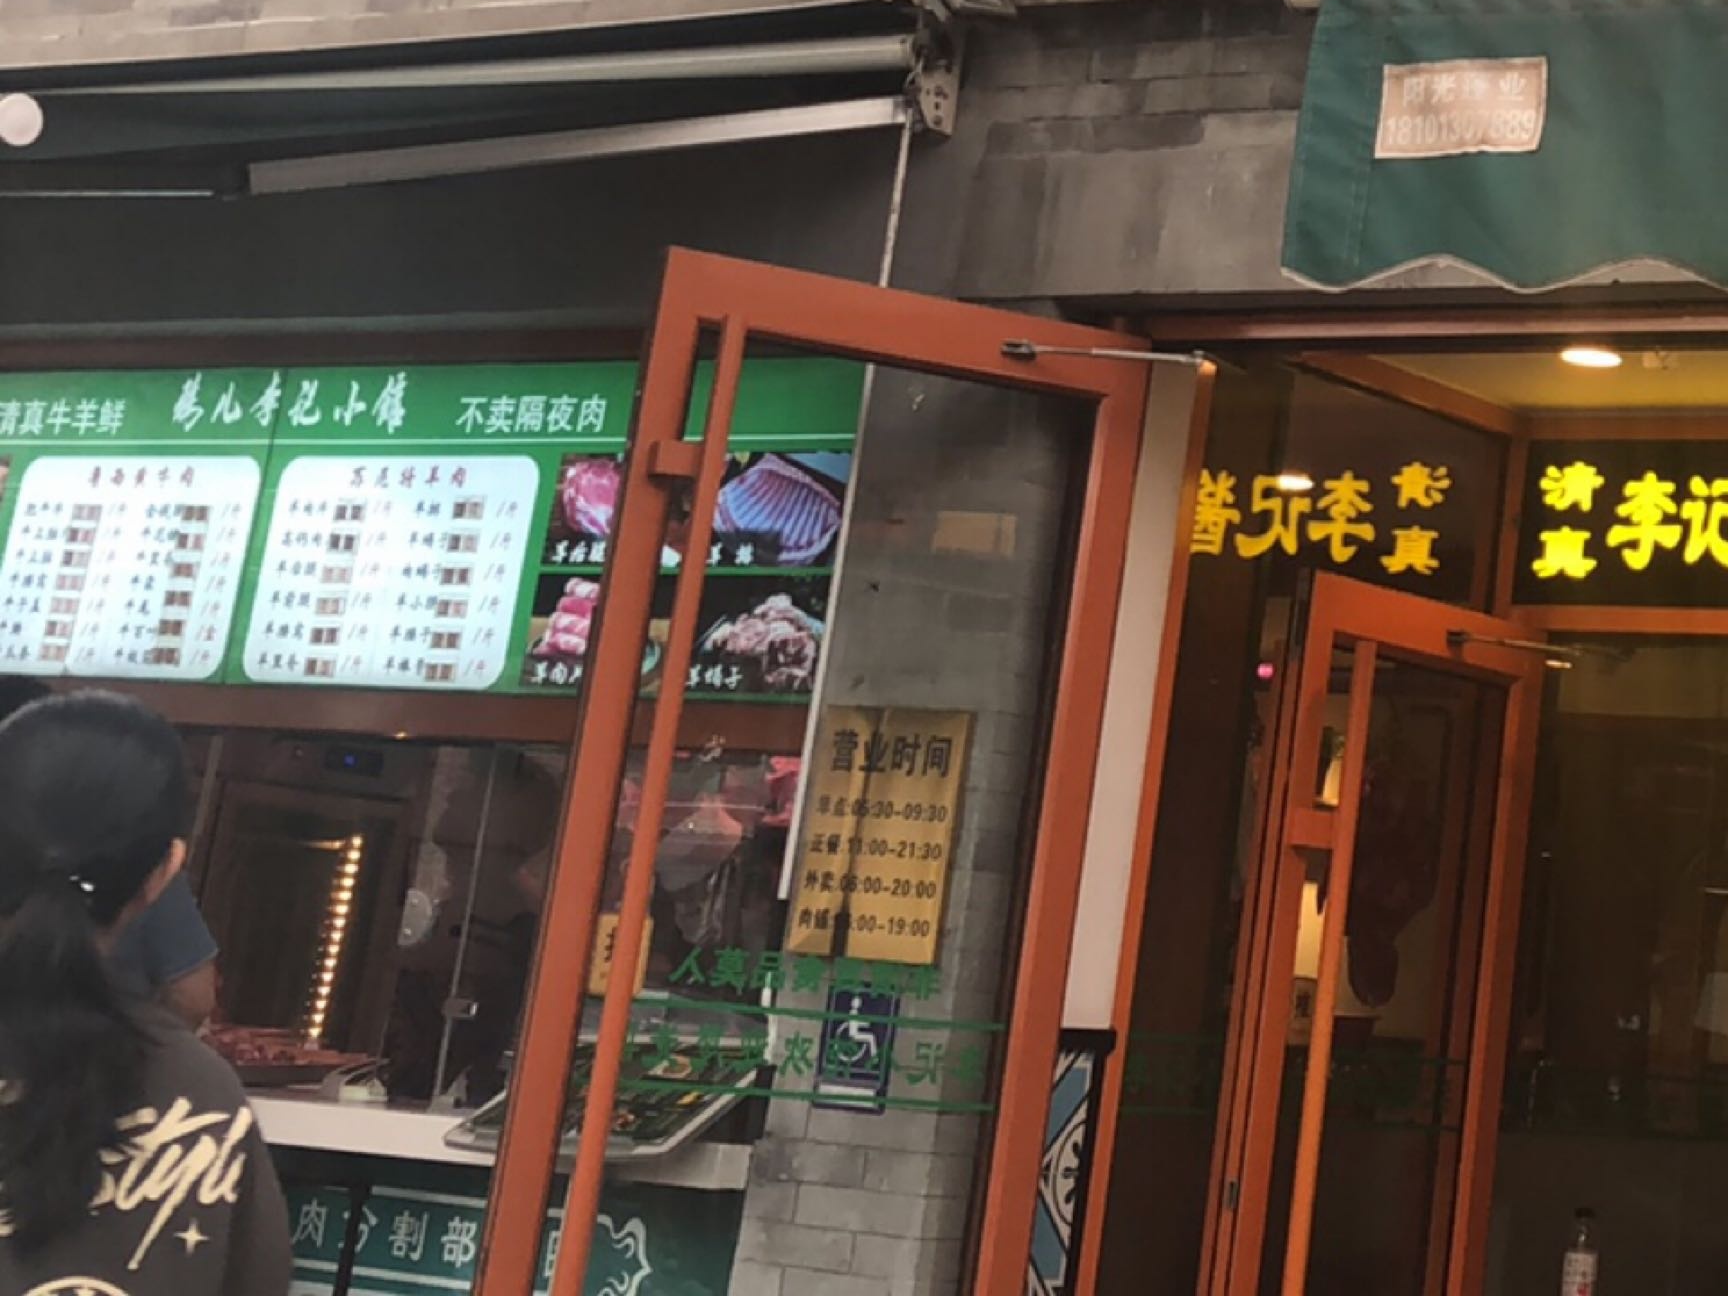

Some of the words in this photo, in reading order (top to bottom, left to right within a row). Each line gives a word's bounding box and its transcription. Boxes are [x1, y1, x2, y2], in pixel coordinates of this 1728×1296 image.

[455, 393, 607, 433] 不卖隔夜肉
[1532, 460, 1604, 580] 清真
[830, 728, 953, 778] 营业时间
